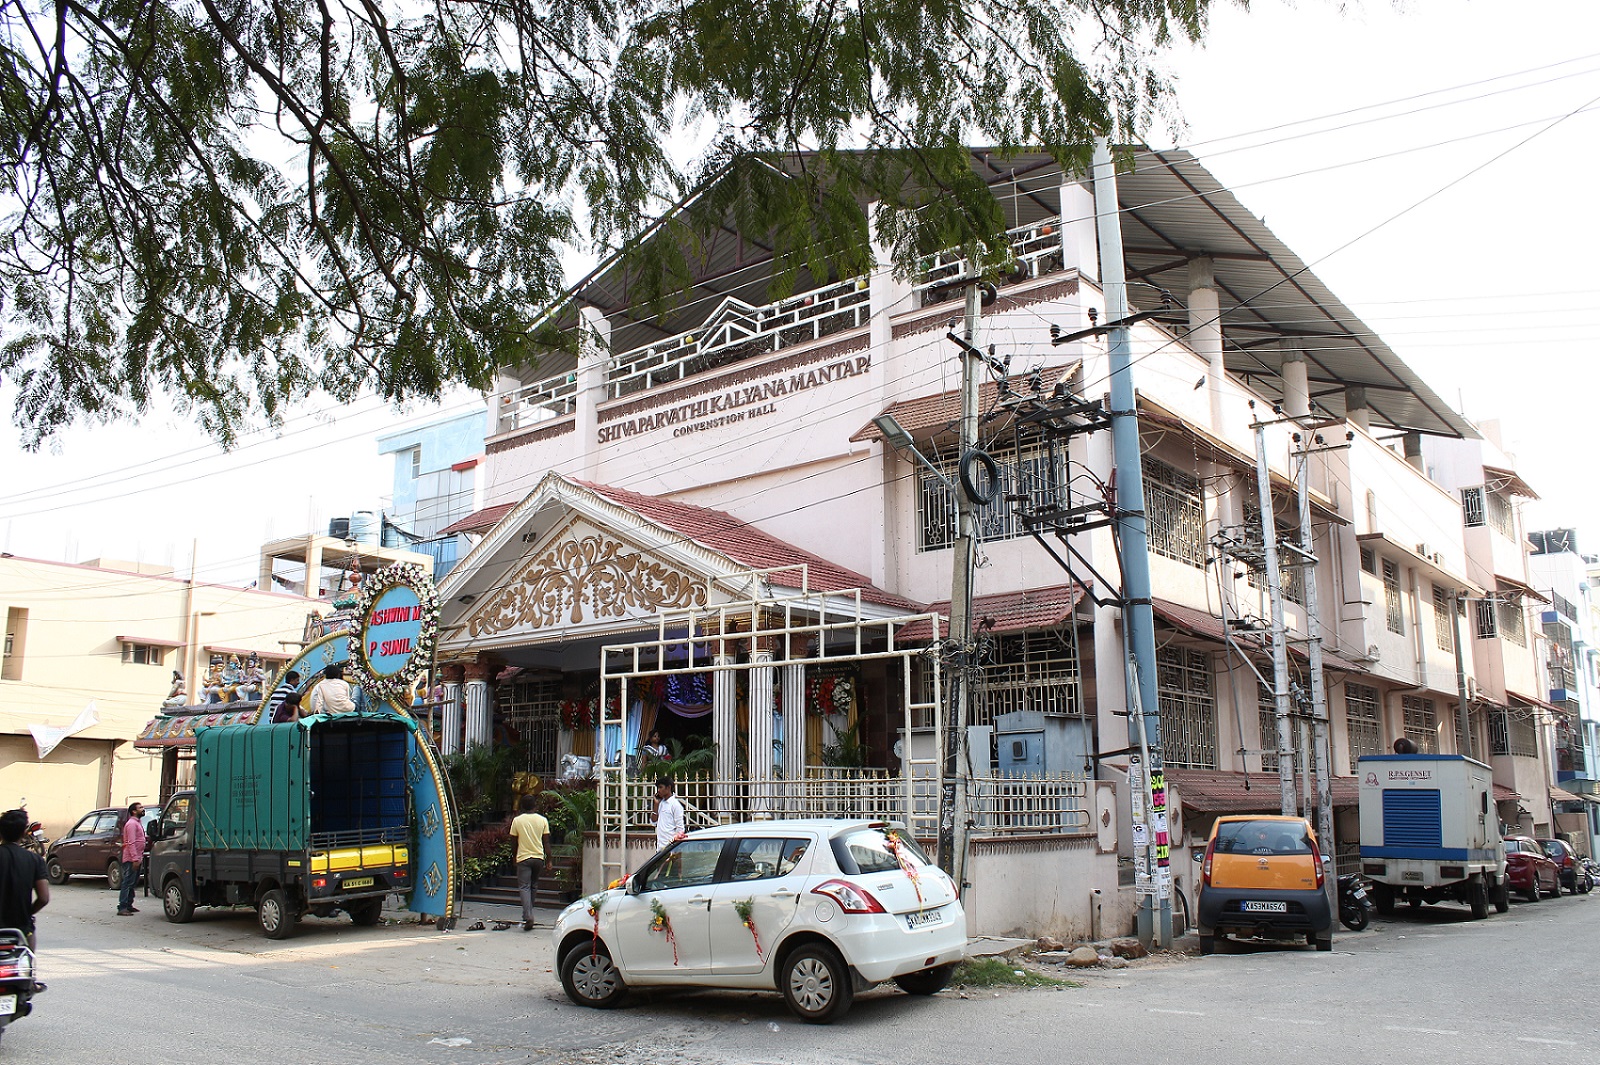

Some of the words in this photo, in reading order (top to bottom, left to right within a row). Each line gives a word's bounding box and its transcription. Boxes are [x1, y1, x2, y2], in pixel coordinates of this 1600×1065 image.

[597, 399, 709, 444] SHIVAPARVATHI
[710, 377, 787, 415] KALYANA
[673, 411, 745, 438] CONVENSTION
[748, 402, 777, 419] HALL
[370, 606, 411, 626] ASHWINI
[369, 641, 378, 657] P
[380, 638, 413, 657] SUNIL
